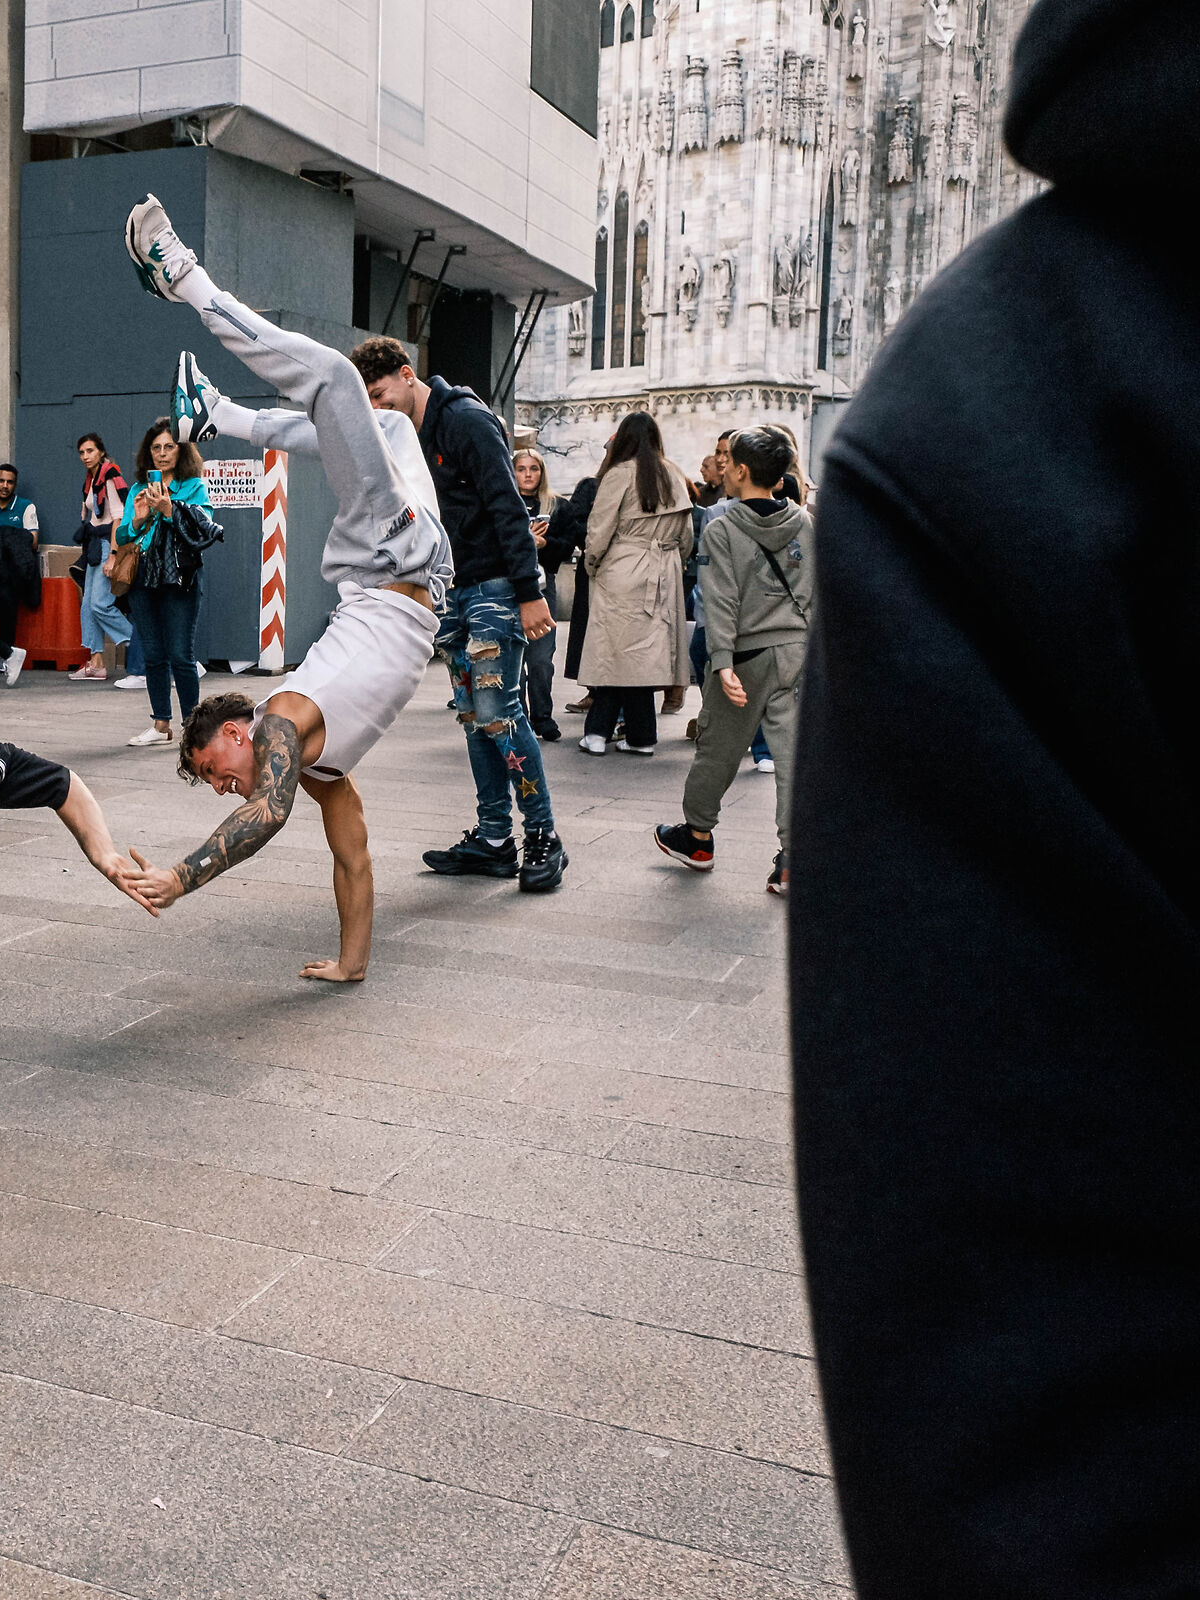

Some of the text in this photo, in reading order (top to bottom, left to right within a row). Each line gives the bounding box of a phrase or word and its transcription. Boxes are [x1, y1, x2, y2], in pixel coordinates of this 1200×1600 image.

[203, 468, 215, 478] Di
[219, 468, 252, 478] Falco
[208, 478, 256, 486] NOLEGGIO
